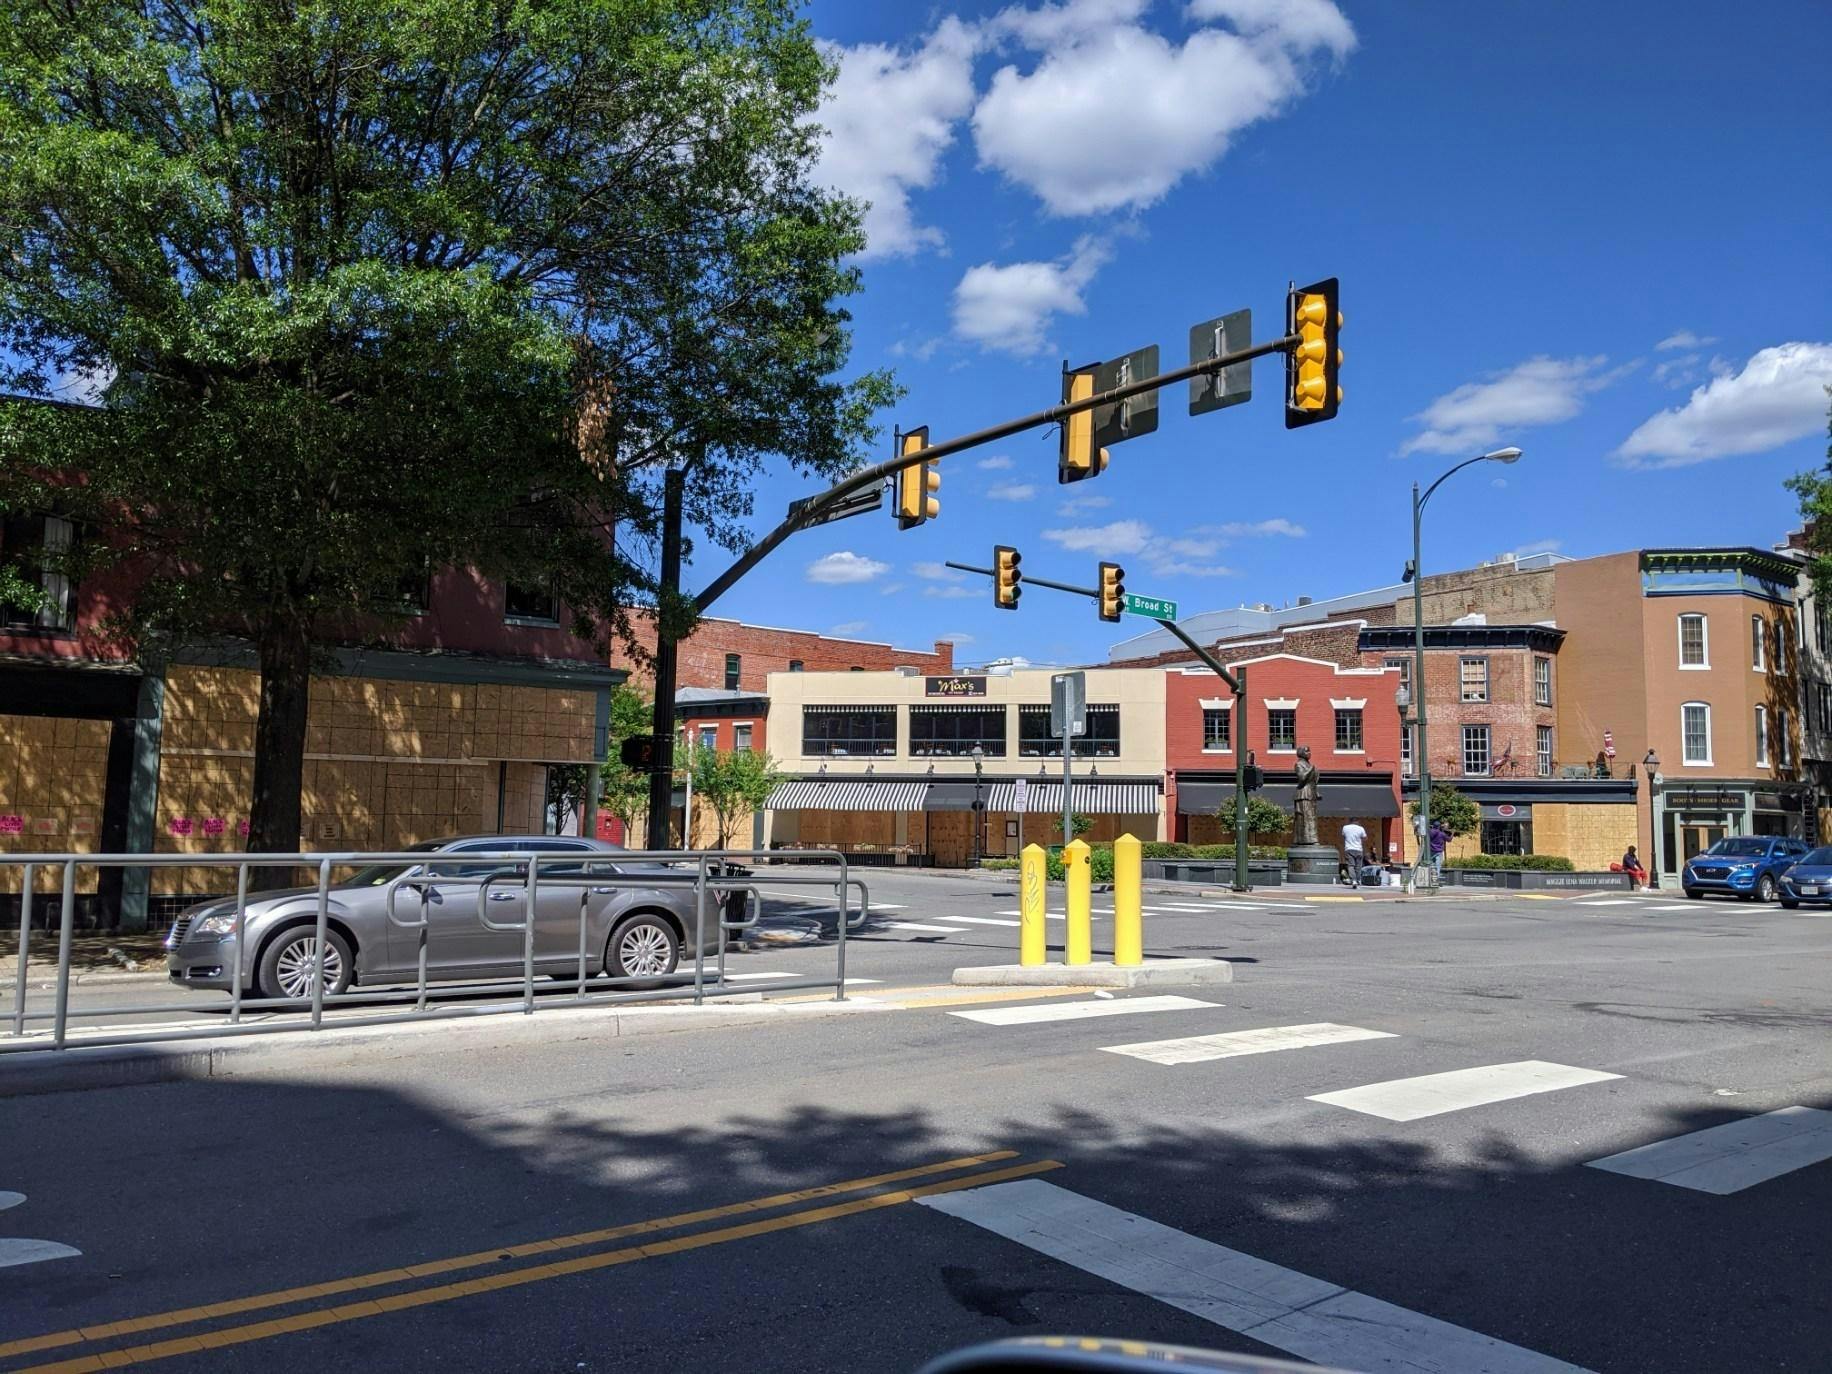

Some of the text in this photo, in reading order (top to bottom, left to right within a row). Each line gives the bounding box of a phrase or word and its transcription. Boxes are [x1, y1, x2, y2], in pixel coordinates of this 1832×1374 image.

[1134, 597, 1160, 612] Broad
[1163, 603, 1173, 614] St
[937, 679, 975, 692] Max's
